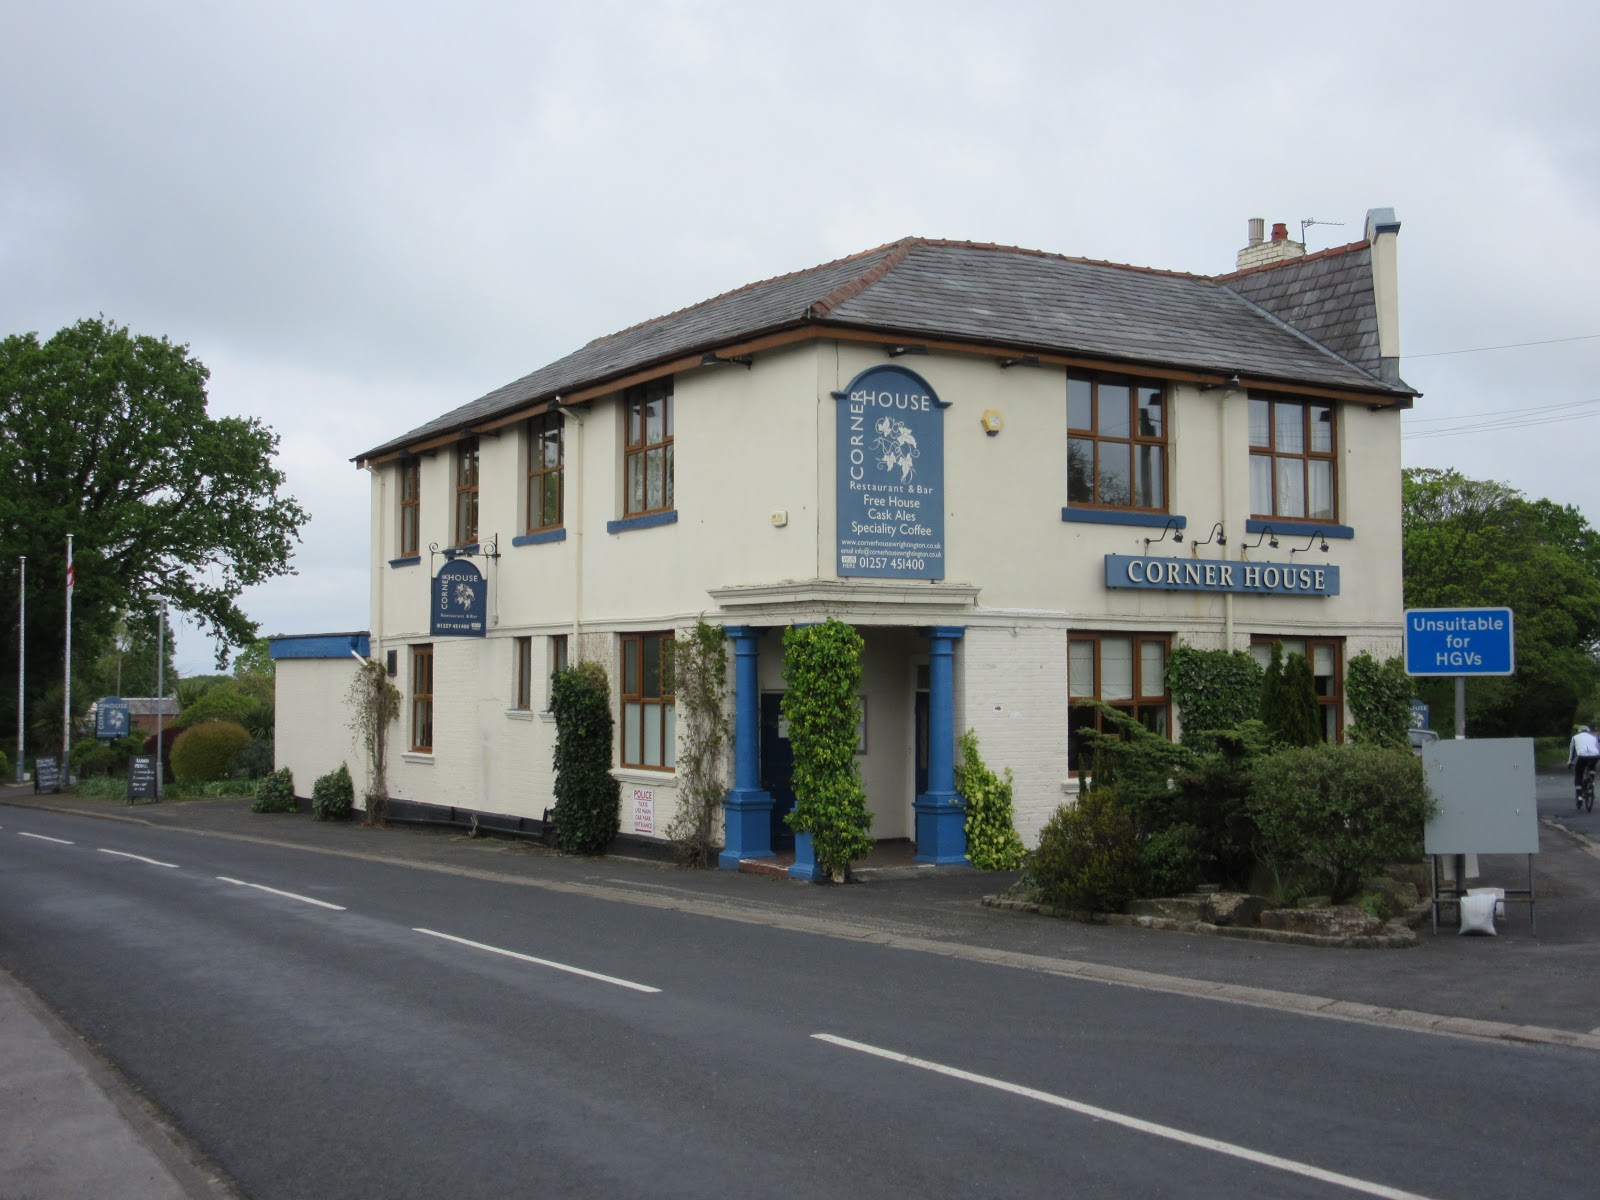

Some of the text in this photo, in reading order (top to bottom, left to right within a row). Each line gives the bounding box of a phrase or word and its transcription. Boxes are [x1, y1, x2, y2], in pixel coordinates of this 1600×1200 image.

[863, 390, 930, 411] HOUSE
[850, 390, 864, 480] CORNER
[850, 481, 933, 495] Restaurant & Bar
[864, 494, 920, 508] Free House
[868, 508, 916, 521] Cask Ales
[851, 521, 932, 537] Speciality Coffee
[860, 557, 888, 569] 01257
[890, 558, 925, 570] 451400
[448, 574, 479, 582] HOUSE
[1127, 560, 1326, 590] CORNER HOUSE
[441, 574, 449, 610] CORNER
[1413, 617, 1504, 631] Unsuitable
[1446, 634, 1471, 648] for
[1436, 651, 1482, 666] HGVs
[634, 790, 652, 799] POLICE
